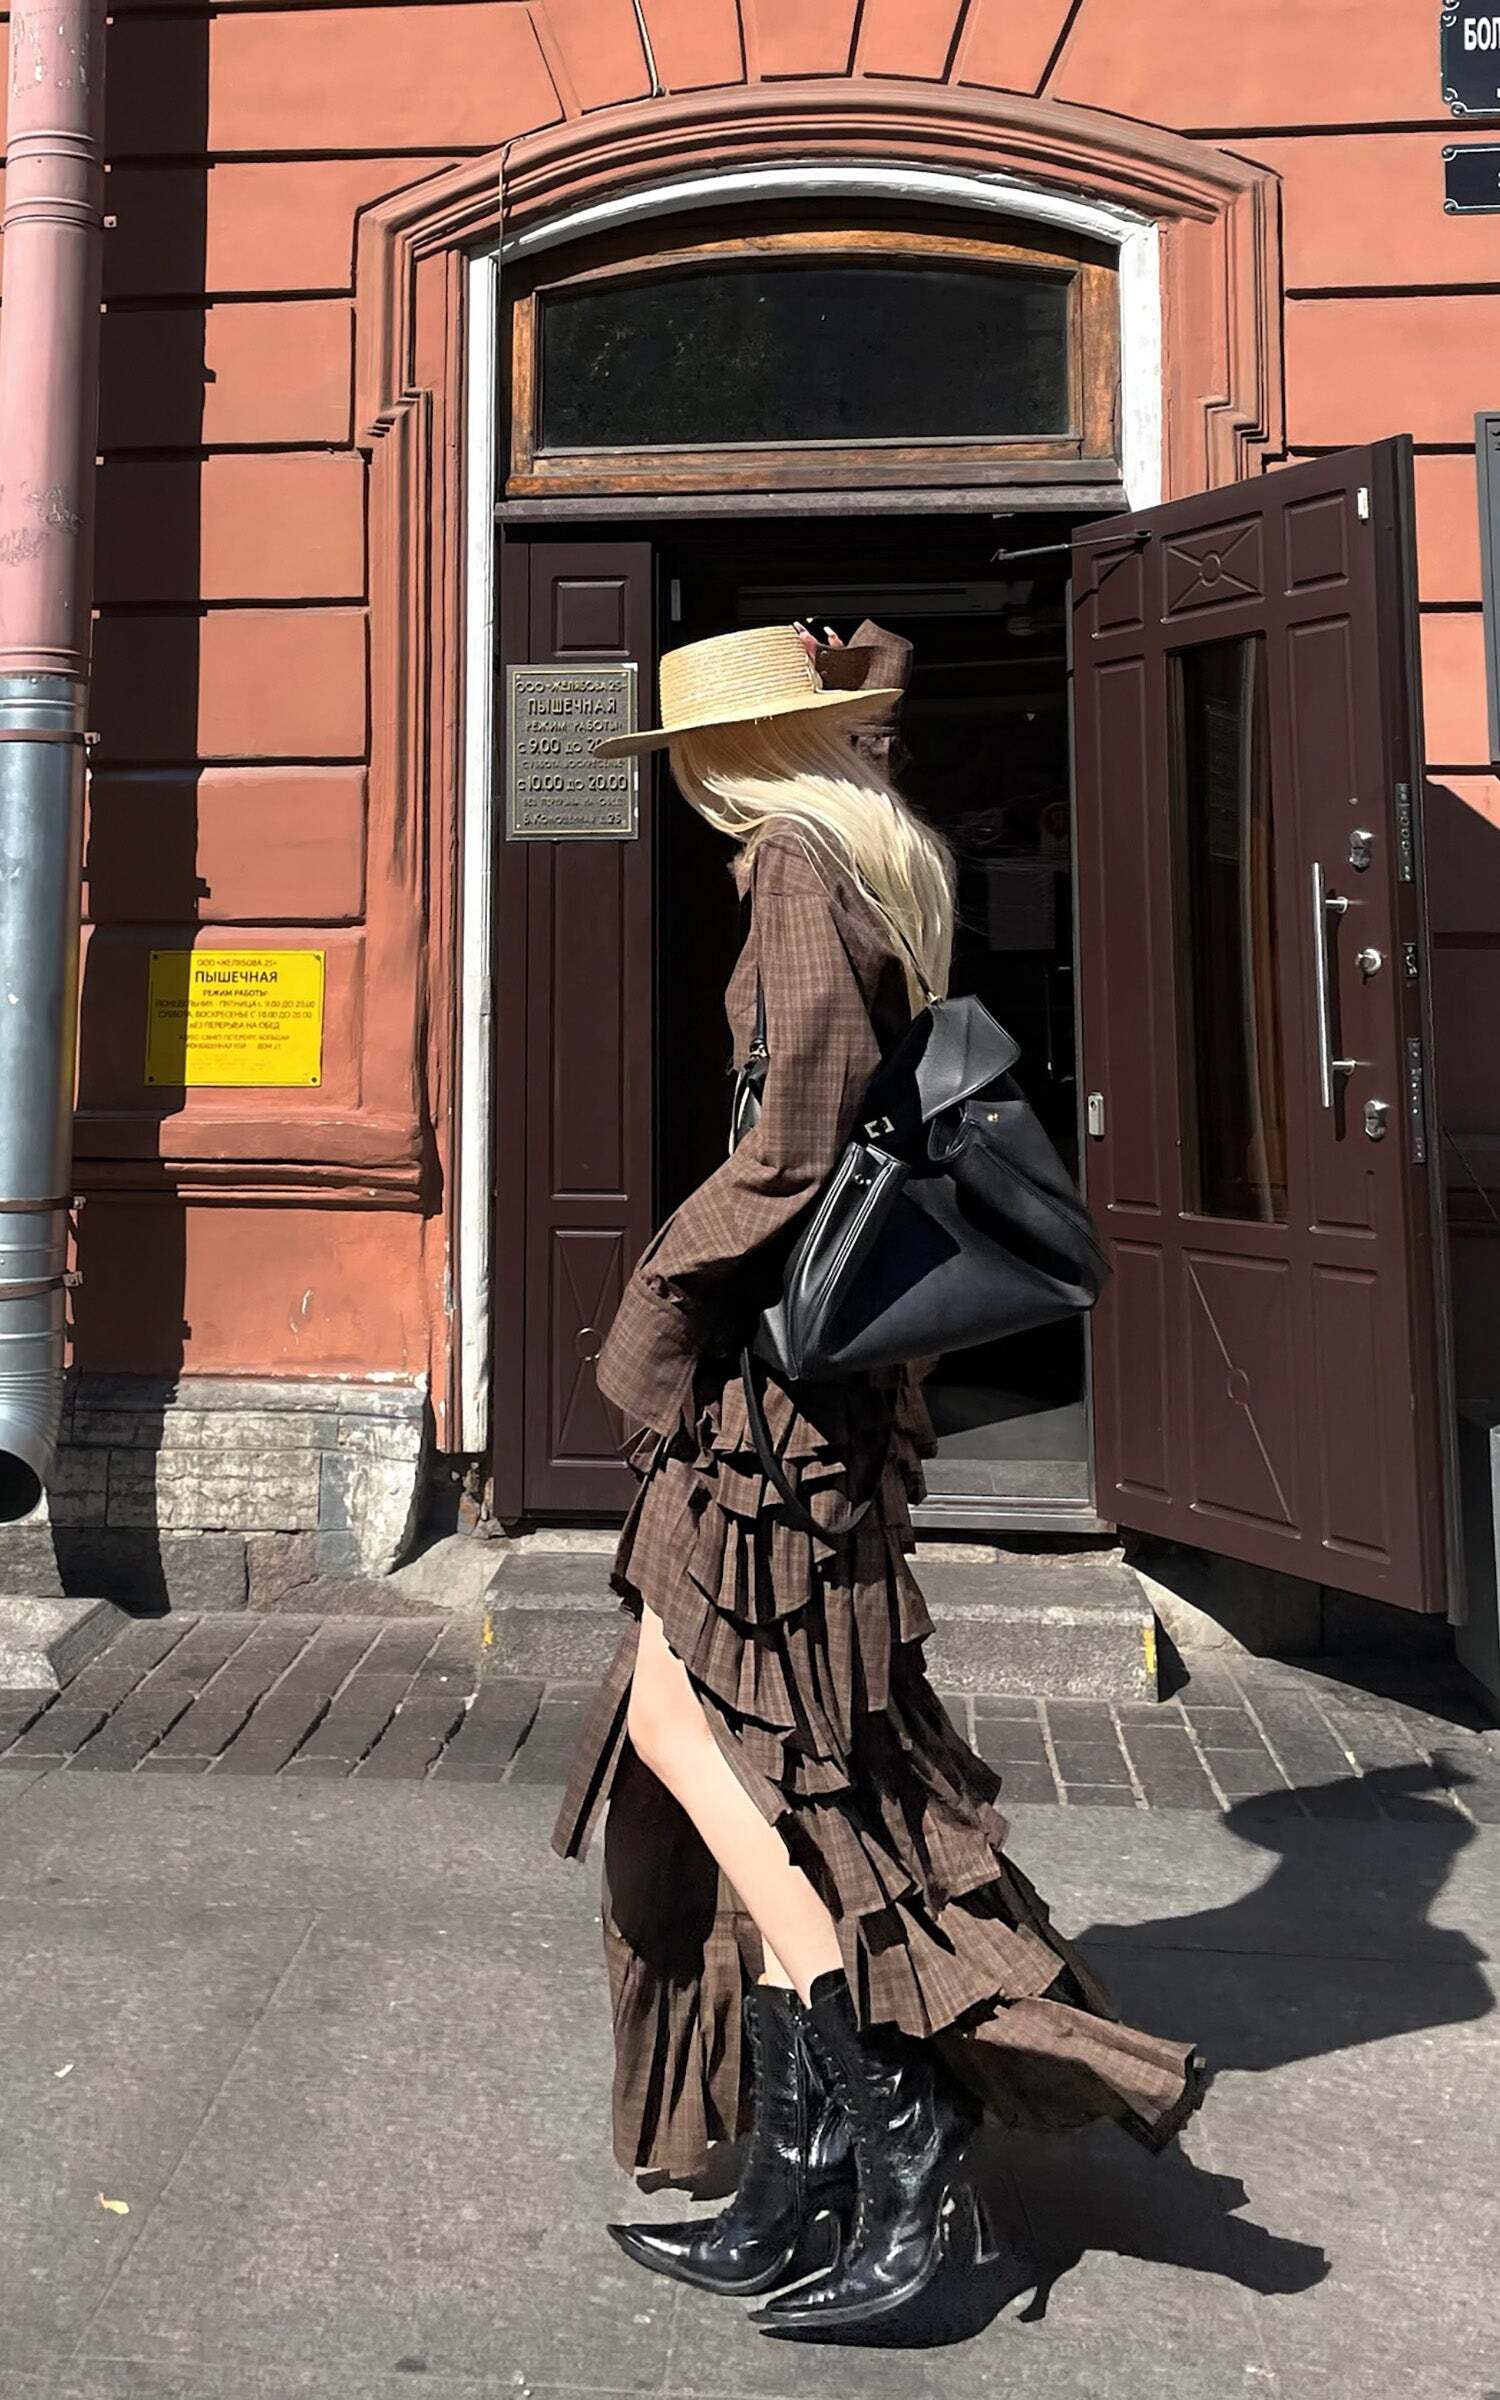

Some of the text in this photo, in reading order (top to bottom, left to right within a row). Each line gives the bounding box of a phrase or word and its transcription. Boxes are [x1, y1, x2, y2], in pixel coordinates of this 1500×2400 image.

[516, 681, 545, 693] ООО
[528, 698, 617, 715] ПЫШЕЧНАЯ
[526, 721, 567, 733] РЕЖИМ
[529, 738, 560, 755] 9.00
[565, 742, 582, 754] до
[528, 775, 564, 792] 10.00
[567, 780, 585, 792] до
[588, 775, 628, 792] 20.00
[197, 959, 215, 967] ООО
[195, 970, 278, 983] ПЫШЕЧНАЯ
[203, 989, 233, 997] РЕЖИМ
